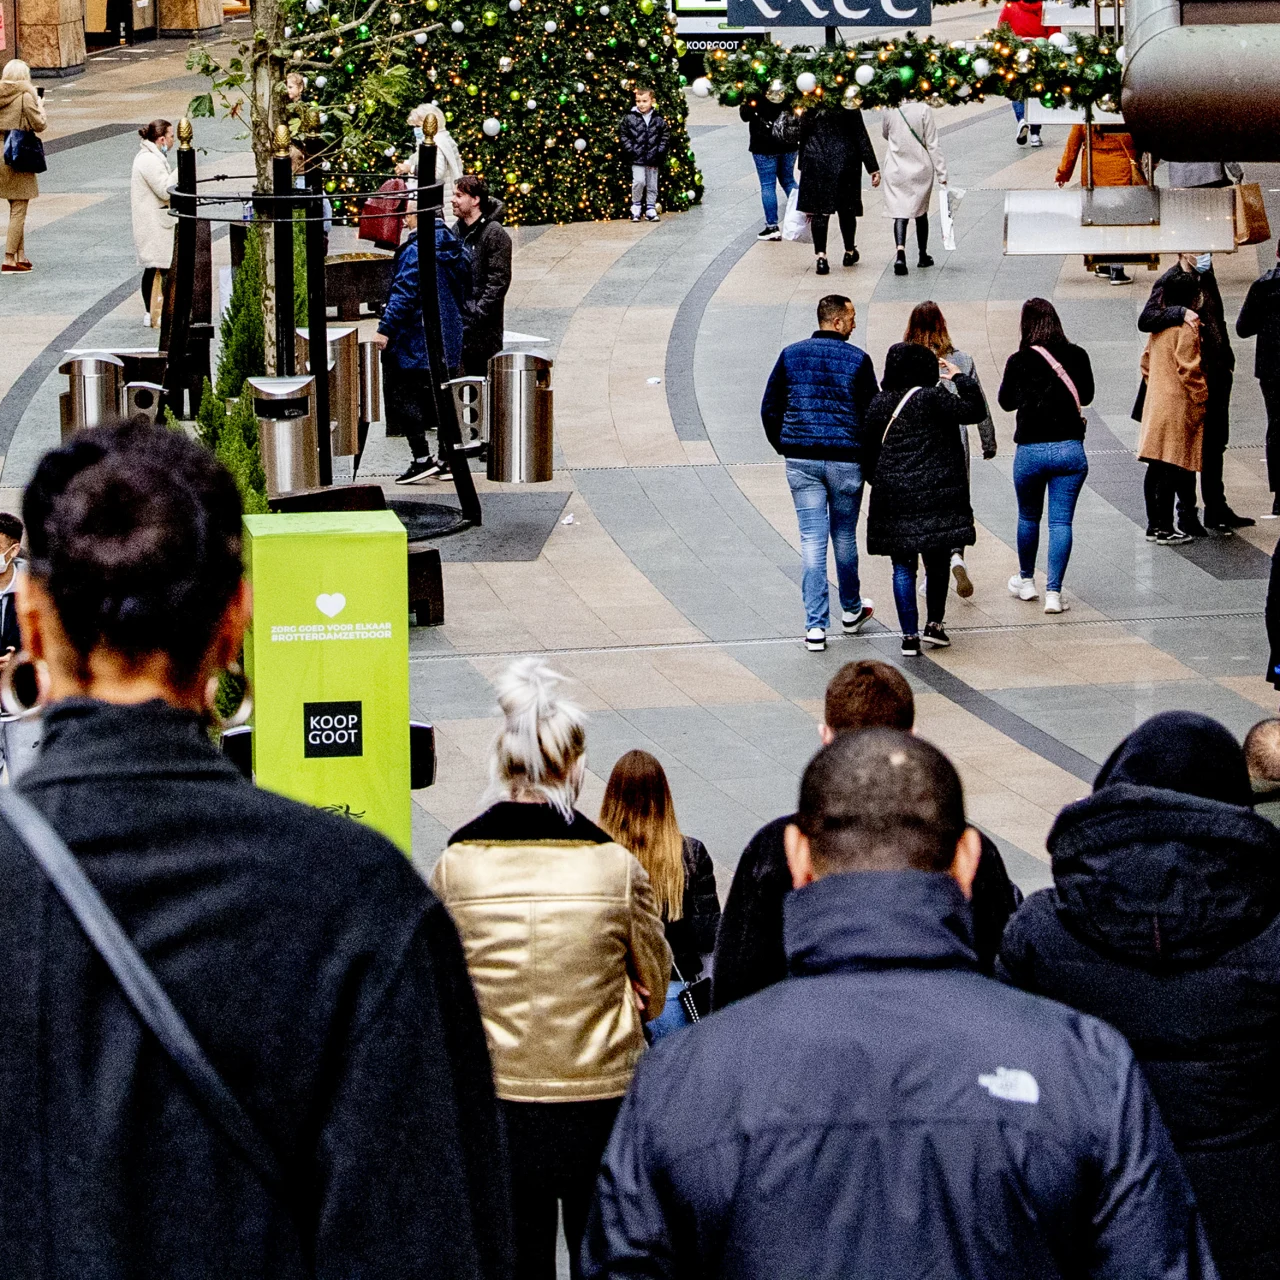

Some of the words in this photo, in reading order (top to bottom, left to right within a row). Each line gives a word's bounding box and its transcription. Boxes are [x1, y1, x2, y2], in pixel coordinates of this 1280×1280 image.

[271, 625, 296, 633] ZORG
[298, 624, 324, 632] GOED
[326, 623, 353, 631] VOOR
[355, 622, 392, 630] ELKAAR
[271, 630, 392, 642] #ROTTERDAMZETDOOR
[310, 714, 358, 729] KOOP
[308, 729, 358, 745] GOOT
